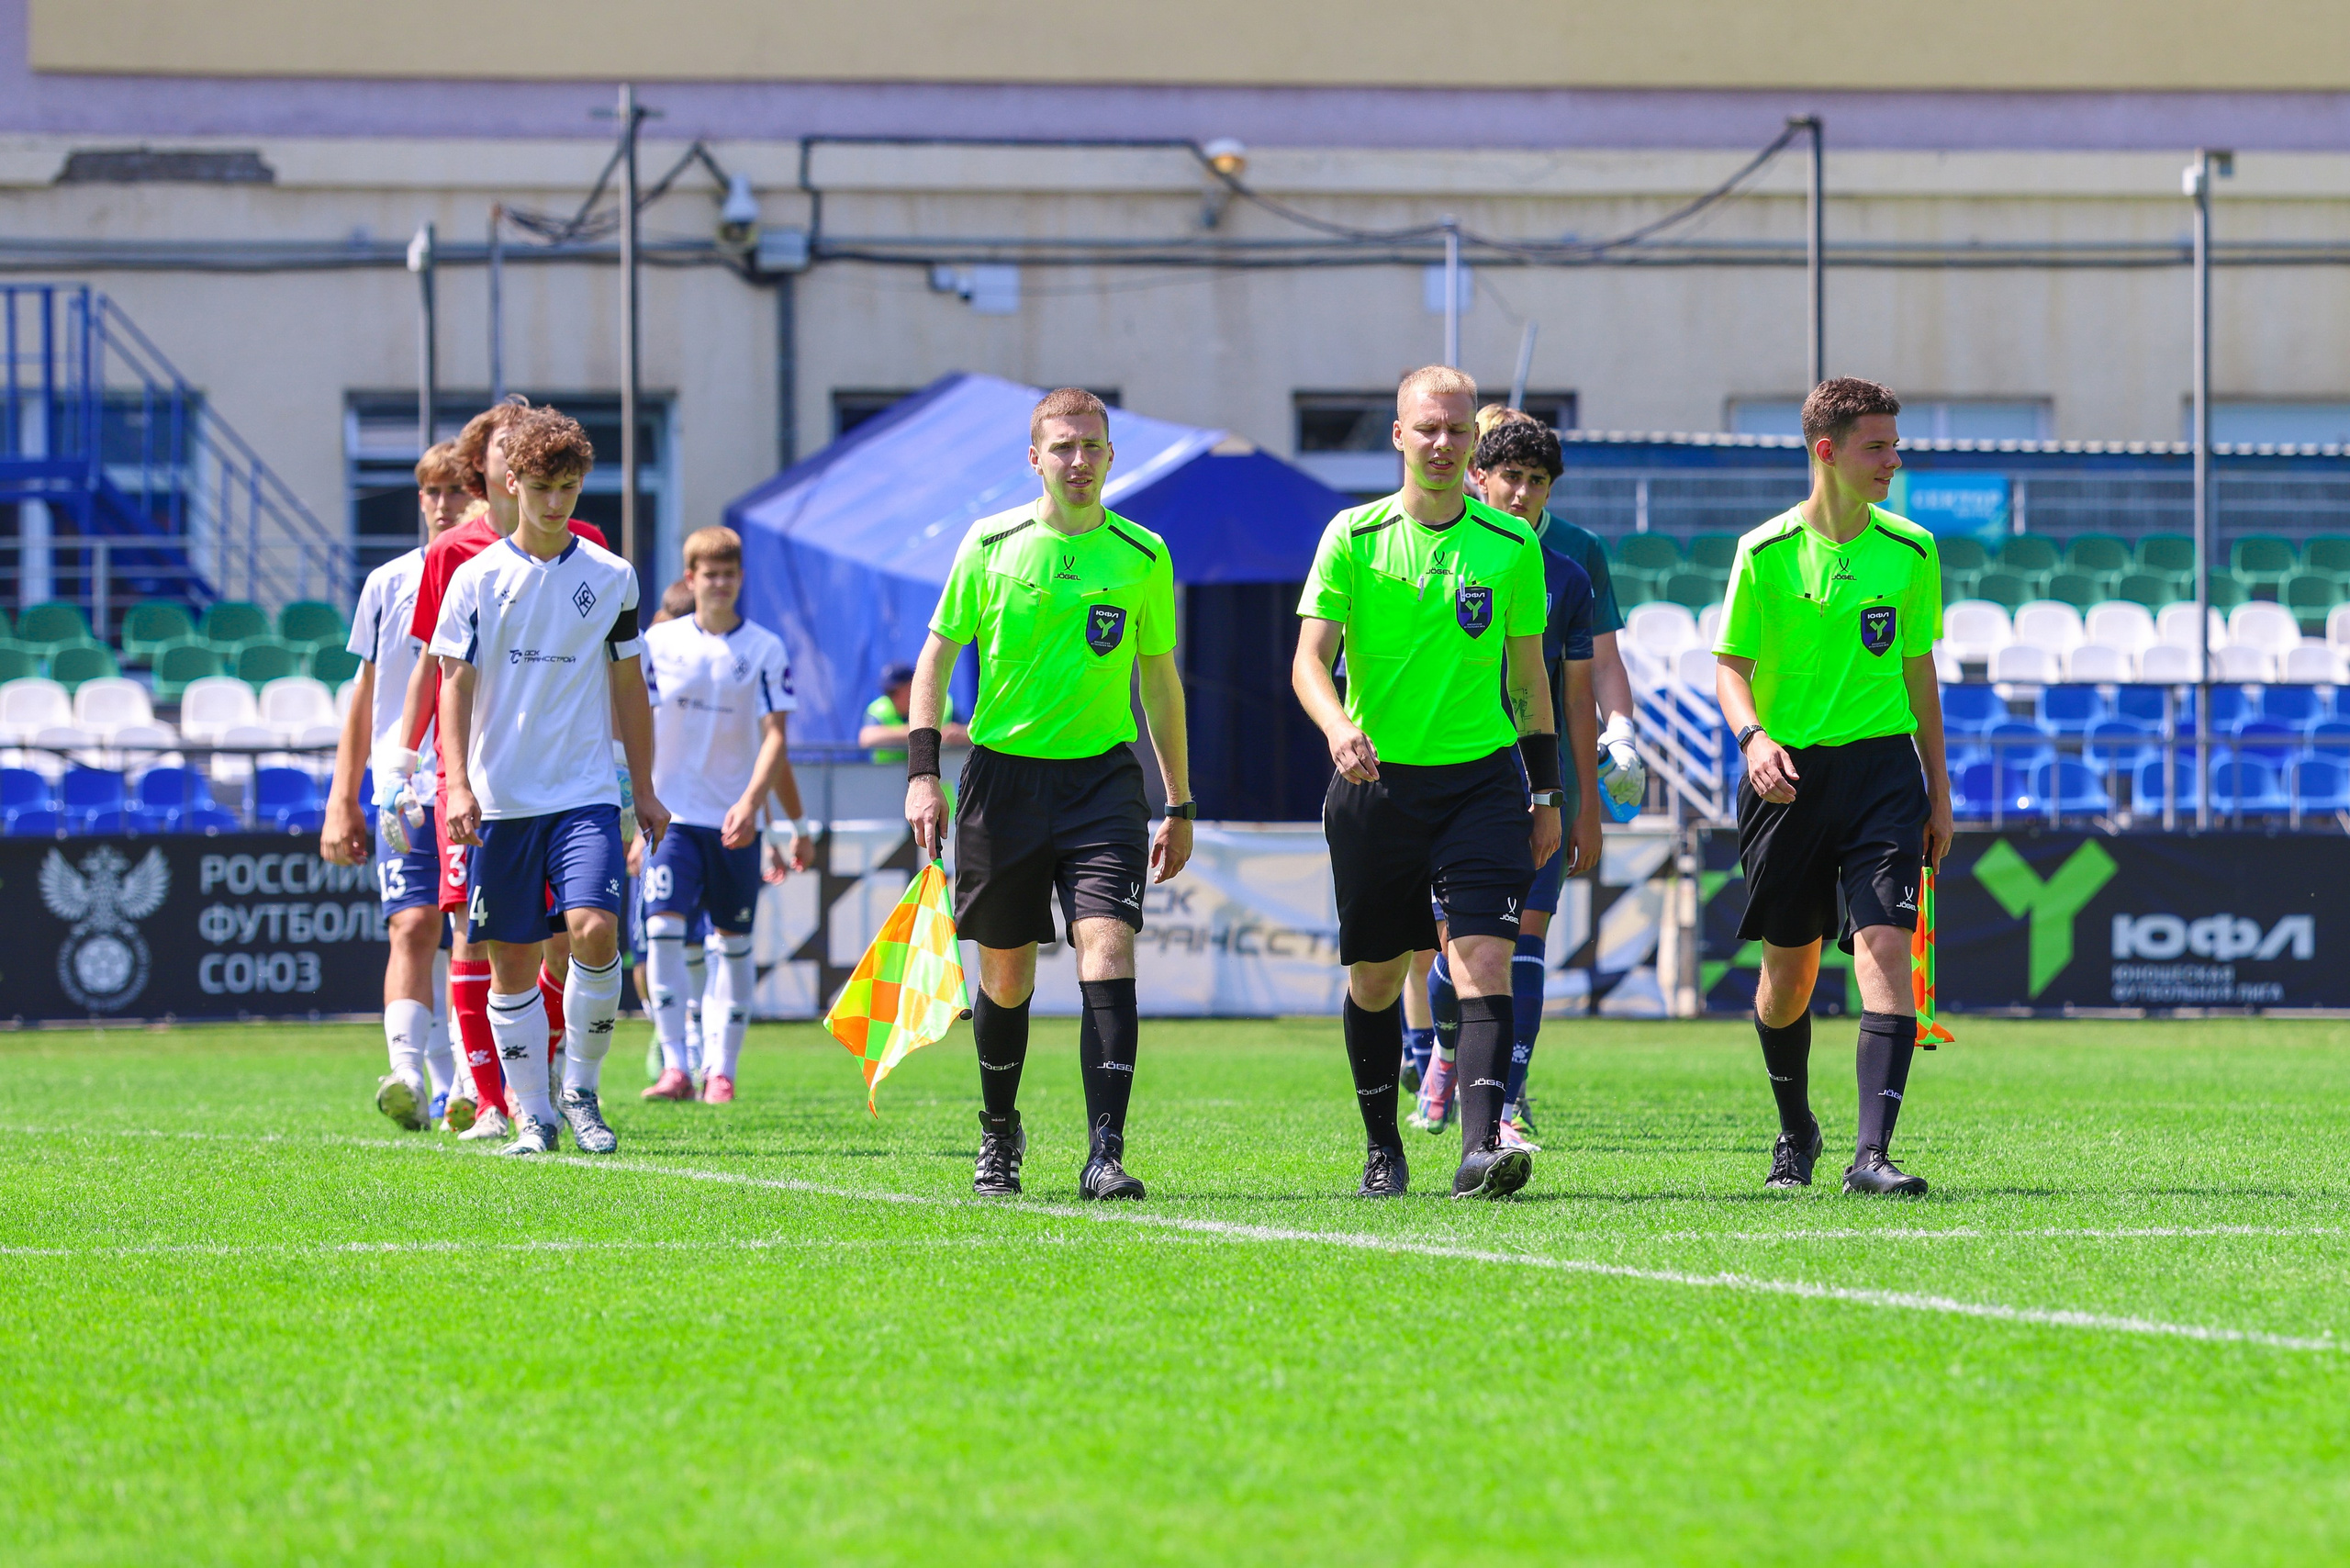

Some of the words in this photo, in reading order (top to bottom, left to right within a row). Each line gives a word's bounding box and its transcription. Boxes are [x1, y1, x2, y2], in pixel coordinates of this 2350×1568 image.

[1054, 572, 1081, 581] JÖGEL
[1425, 566, 1454, 575] JÖGEL
[1095, 610, 1119, 619] ЮФЛ
[1867, 611, 1889, 620] ЮФЛ
[377, 857, 407, 902] 13
[1143, 885, 1197, 913] СК
[469, 885, 488, 927] 4
[2111, 913, 2315, 961] ЮФЛ
[198, 952, 321, 994] СОЮЗ
[979, 1059, 1020, 1071] JÖGEL
[1097, 1060, 1134, 1073] JÖGEL
[1356, 1083, 1393, 1096] JÖGEL
[1469, 1078, 1506, 1092] JÖGEL
